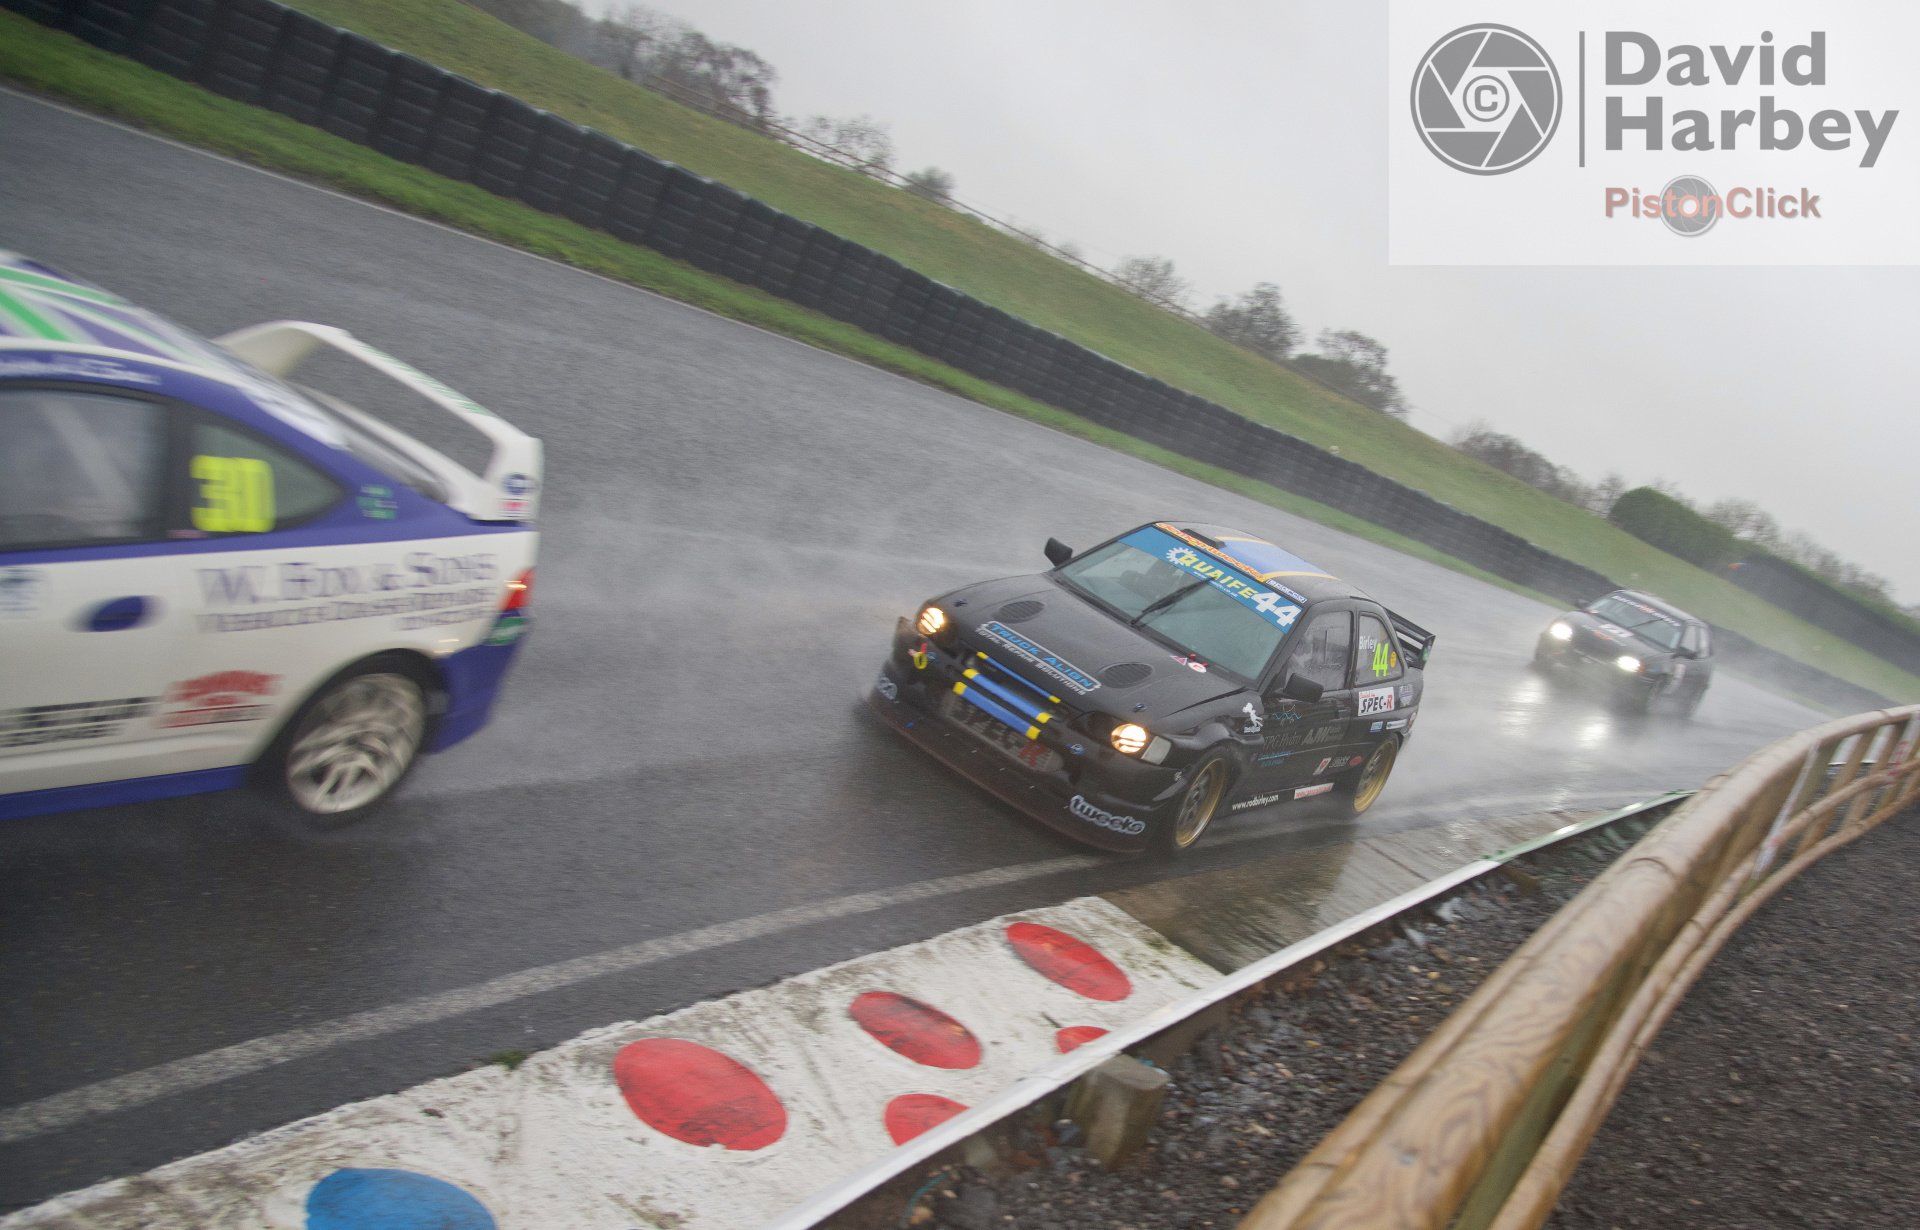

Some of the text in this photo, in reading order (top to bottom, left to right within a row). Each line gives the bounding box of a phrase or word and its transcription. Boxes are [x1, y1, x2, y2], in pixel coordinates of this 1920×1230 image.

[191, 455, 275, 532] 30
[1178, 553, 1259, 599] QUAIFE
[1251, 591, 1302, 627] 44
[1043, 656, 1094, 688] ALIGN
[1372, 642, 1390, 678] 44
[1361, 694, 1393, 713] SPEC-R
